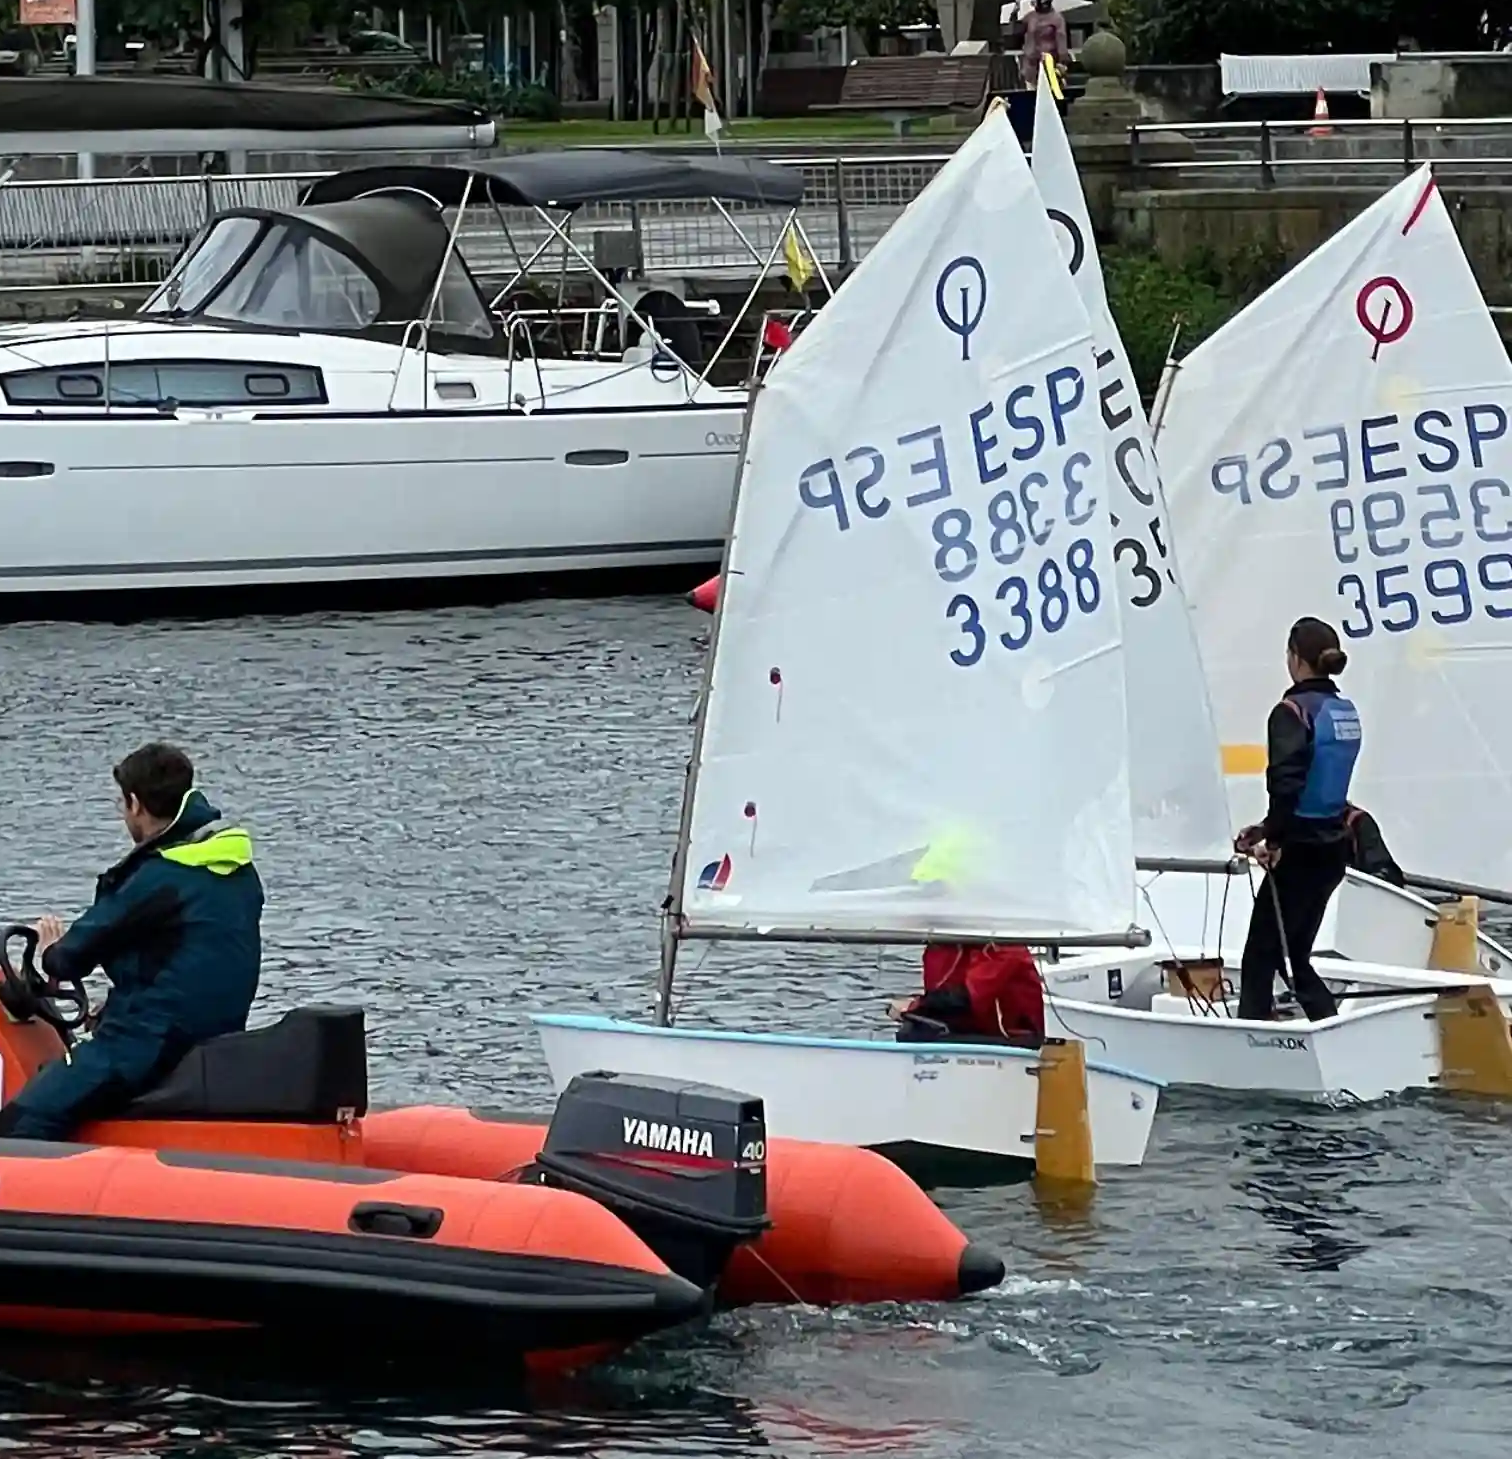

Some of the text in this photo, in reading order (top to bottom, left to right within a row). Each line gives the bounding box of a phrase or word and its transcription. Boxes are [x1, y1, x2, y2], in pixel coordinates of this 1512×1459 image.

[969, 366, 1085, 484] ESP
[1360, 403, 1508, 483] ESP
[945, 538, 1101, 667] 3388
[1338, 553, 1512, 639] 3599
[623, 1116, 765, 1161] YAMAHA 40
